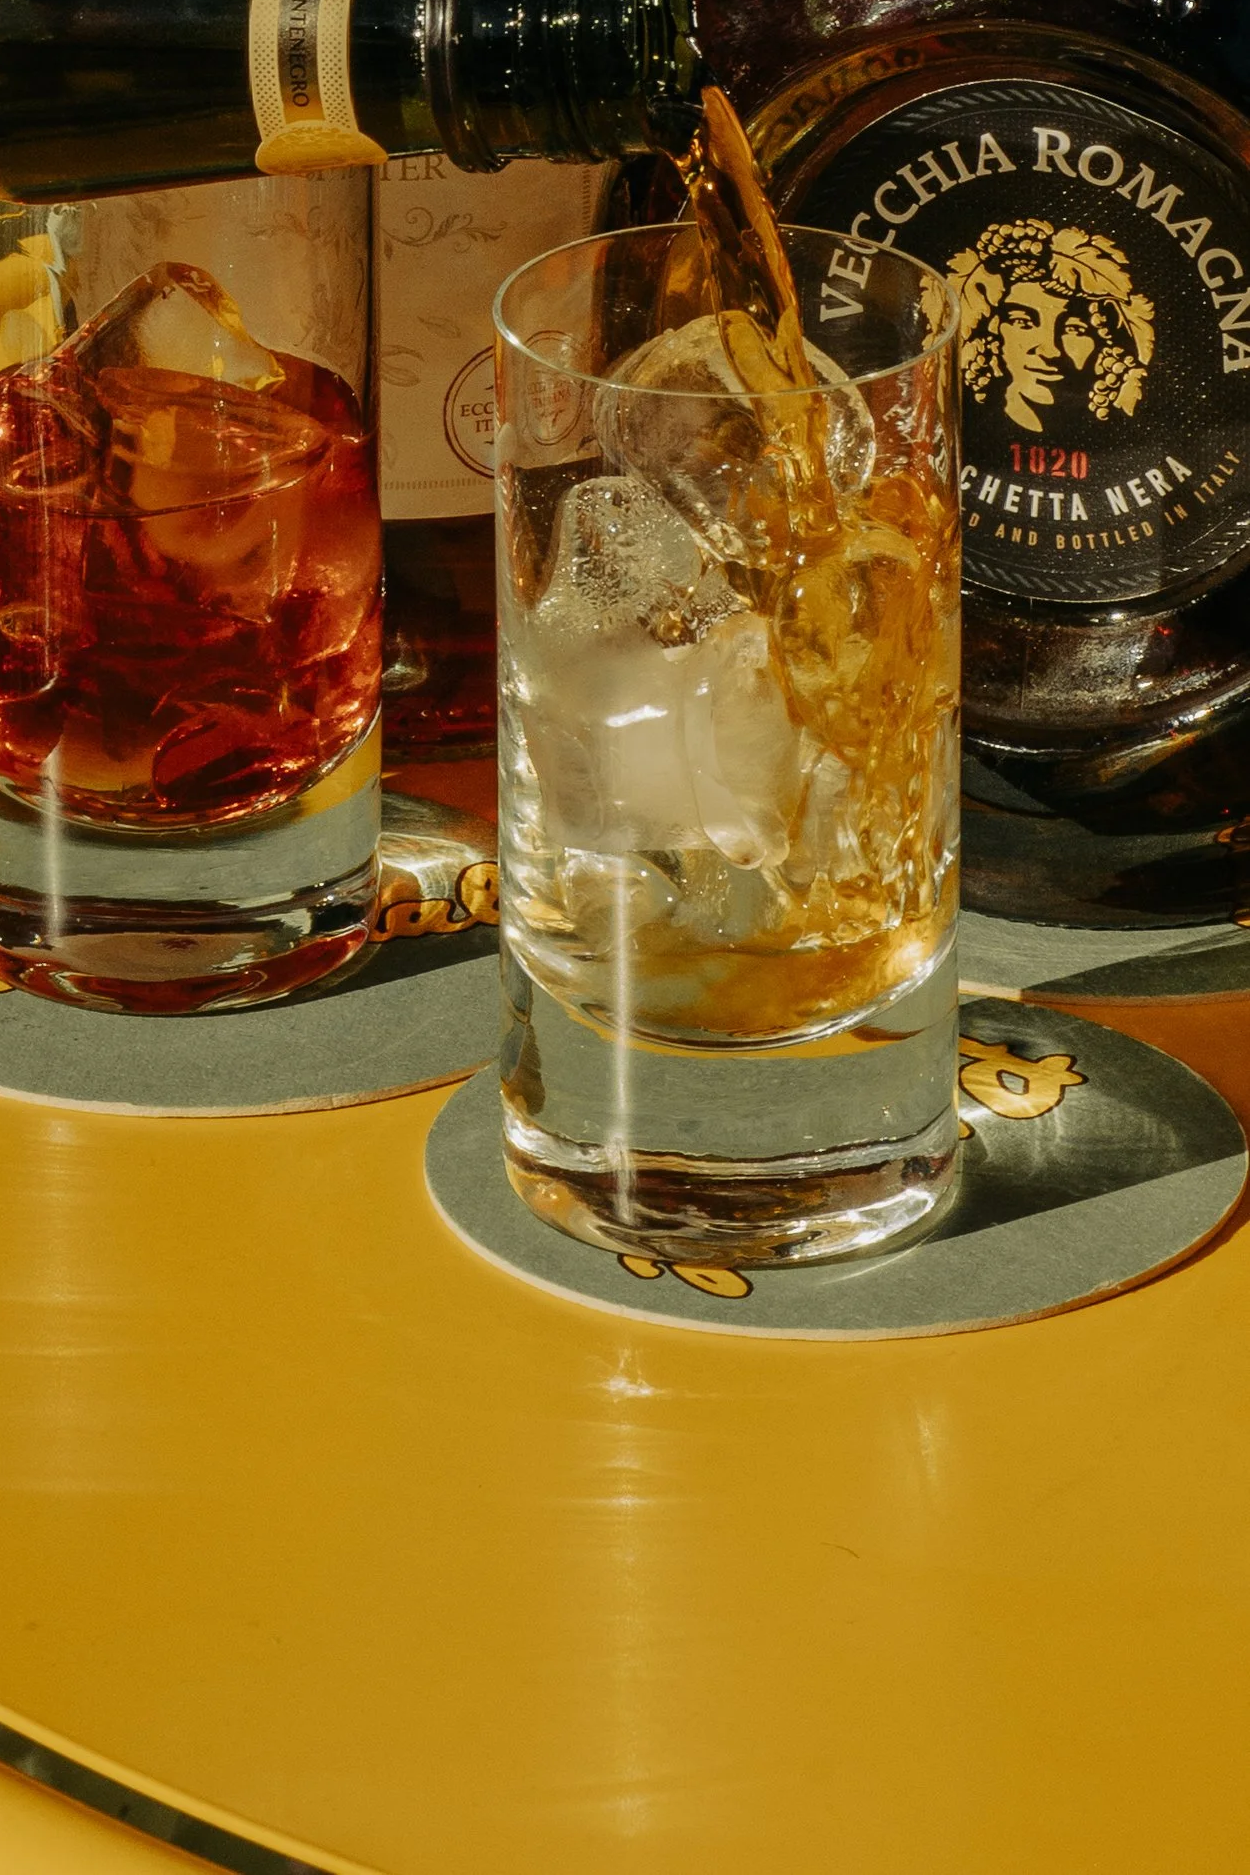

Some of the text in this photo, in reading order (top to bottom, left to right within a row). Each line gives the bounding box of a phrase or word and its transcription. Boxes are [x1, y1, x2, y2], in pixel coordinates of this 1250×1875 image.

[819, 126, 1250, 374] VECCHIA ROMAGNA
[960, 455, 1193, 521] CHETTA NERA
[995, 450, 1241, 550] AND BOTTLED IN ITALY
[1010, 443, 1090, 480] 1820
